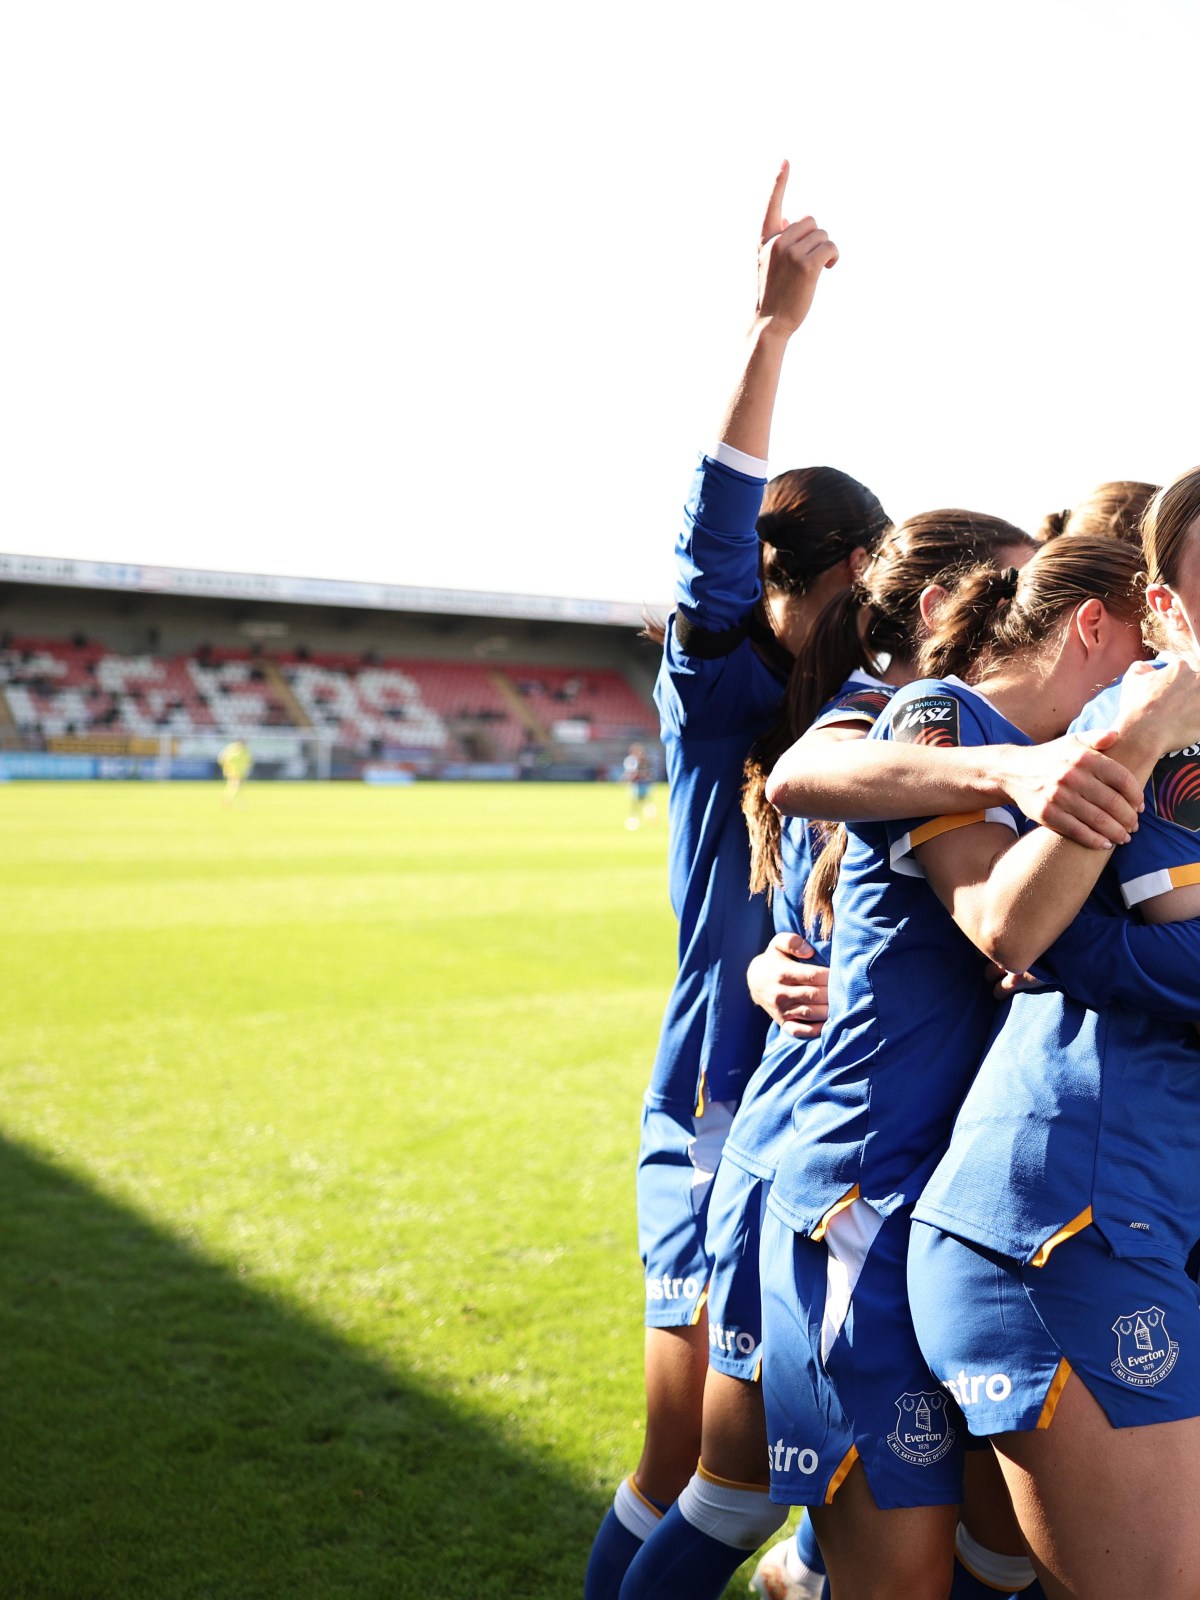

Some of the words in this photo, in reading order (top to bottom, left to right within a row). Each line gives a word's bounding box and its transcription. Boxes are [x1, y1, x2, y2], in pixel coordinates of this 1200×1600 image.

[914, 700, 952, 709] BARCLAYS
[896, 707, 953, 732] WSL
[1116, 1369, 1126, 1379] NIL
[1126, 1375, 1144, 1385] SATIS
[1144, 1375, 1159, 1384] NISI
[1159, 1351, 1177, 1378] OPTIMUM
[1127, 1349, 1165, 1367] Everton
[1142, 1362, 1155, 1371] 1878
[942, 1369, 1012, 1405] stro
[904, 1432, 942, 1443] Everton
[891, 1442, 901, 1453] NIL
[900, 1451, 917, 1462] SATIS
[932, 1438, 953, 1460] OPTIMUM
